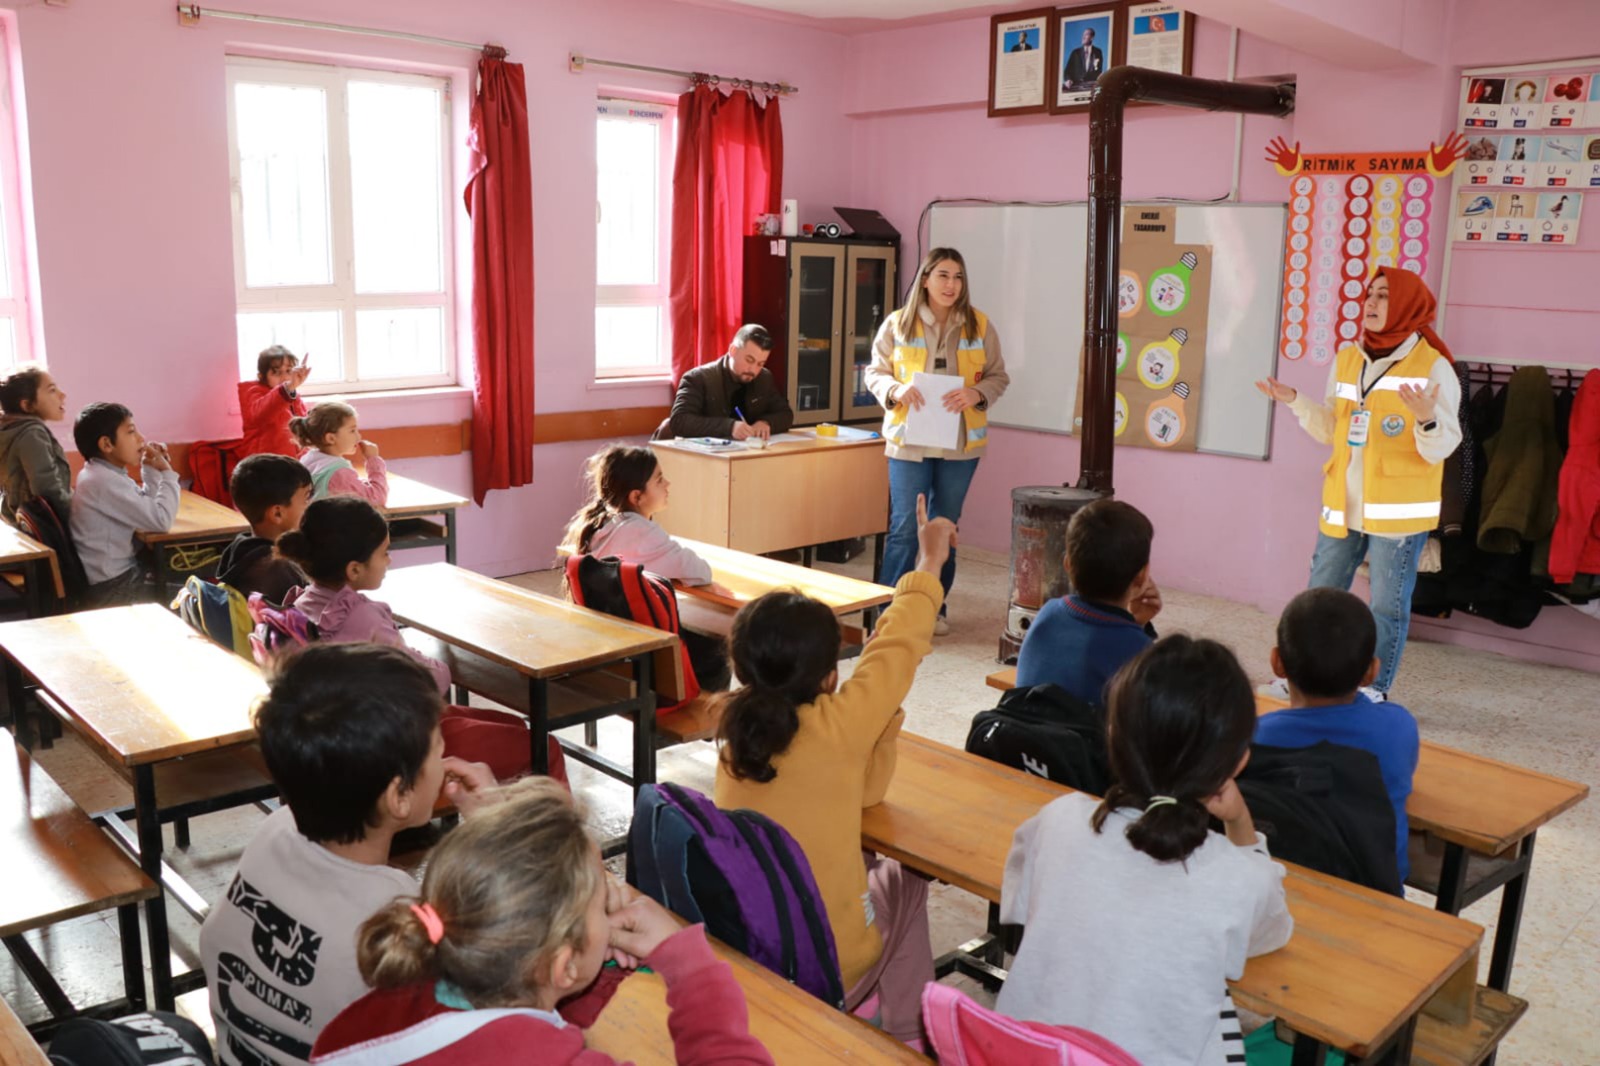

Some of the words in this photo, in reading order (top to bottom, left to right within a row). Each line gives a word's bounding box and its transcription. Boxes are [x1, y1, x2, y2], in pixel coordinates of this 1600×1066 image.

[1472, 107, 1480, 116] A
[1510, 107, 1519, 117] N
[1551, 105, 1560, 115] E
[1369, 157, 1426, 171] SAYMA
[1468, 163, 1479, 174] O
[1505, 163, 1514, 174] K
[1521, 165, 1528, 174] k
[1547, 165, 1557, 175] U
[1299, 180, 1307, 191] 2
[1327, 181, 1334, 193] 3
[1384, 182, 1392, 192] 5
[1412, 182, 1422, 192] 10
[1297, 199, 1304, 212] 4
[1408, 222, 1421, 234] 30
[1504, 220, 1512, 230] S
[1293, 255, 1304, 267] 10
[1315, 347, 1327, 359] 30
[243, 973, 298, 1017] PUMA
